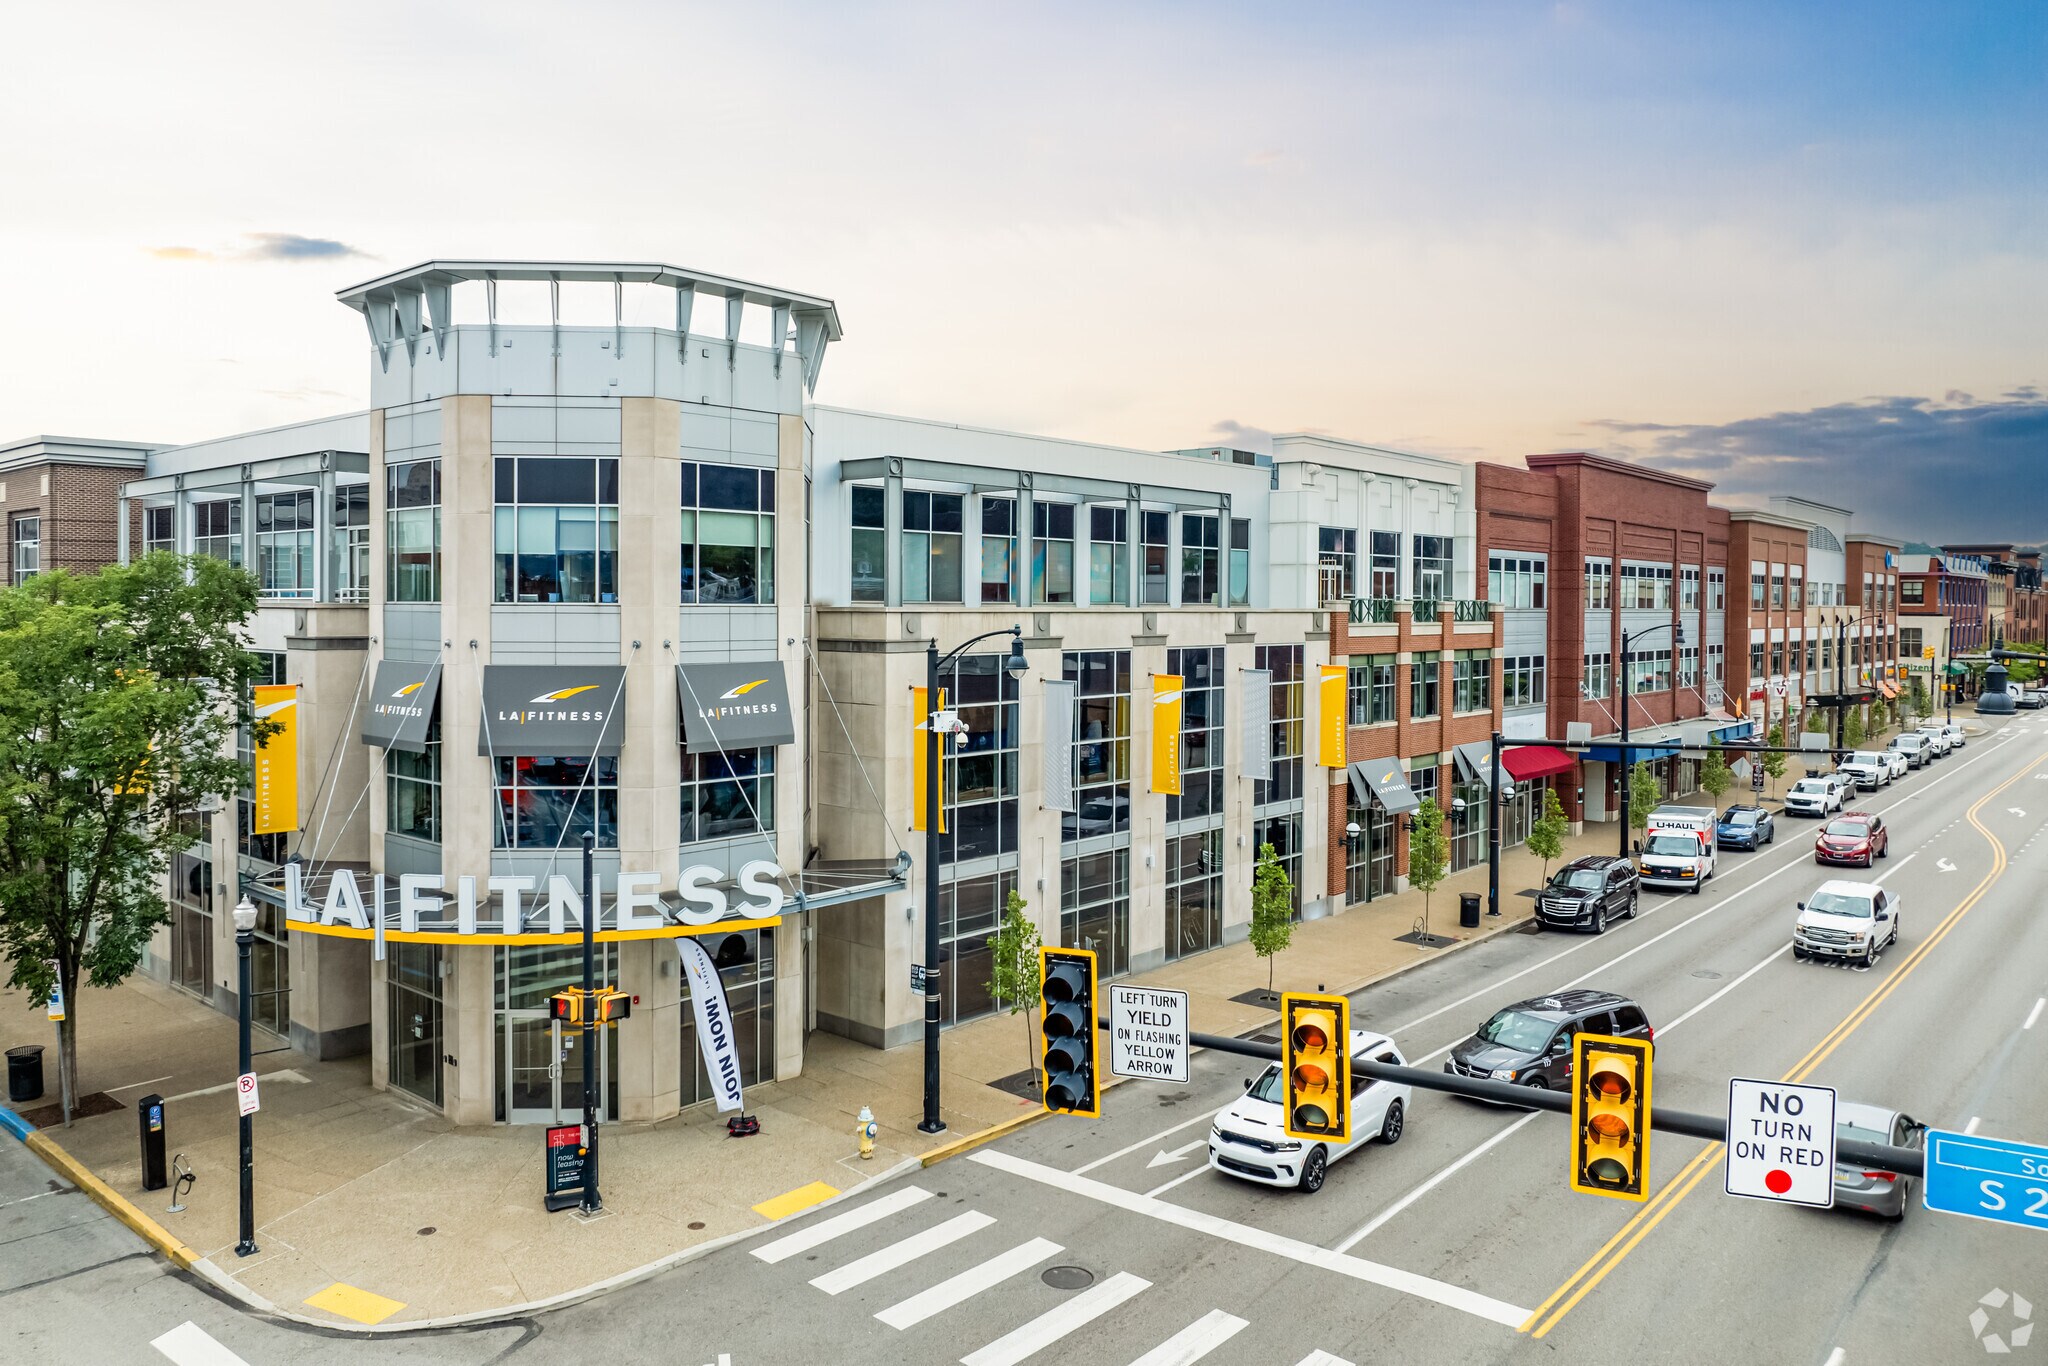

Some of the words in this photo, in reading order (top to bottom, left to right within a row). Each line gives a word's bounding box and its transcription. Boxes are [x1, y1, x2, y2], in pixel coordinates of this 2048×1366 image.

[1656, 821, 1695, 829] U-HAUL
[1120, 991, 1146, 1005] LEFT
[1149, 994, 1178, 1008] TURN
[704, 995, 728, 1052] NOW!
[1127, 1009, 1172, 1027] YIELD
[1117, 1027, 1130, 1040] ON
[1135, 1029, 1181, 1046] FLASHING
[1124, 1043, 1175, 1060] YELLOW
[1127, 1059, 1173, 1075] ARROW
[718, 1054, 740, 1102] JOIN
[1760, 1091, 1804, 1116] NO
[1750, 1118, 1812, 1142] TURN
[557, 1159, 585, 1168] leasing
[1736, 1141, 1765, 1160] ON
[1780, 1146, 1824, 1167] RED
[1979, 1180, 2006, 1211] S
